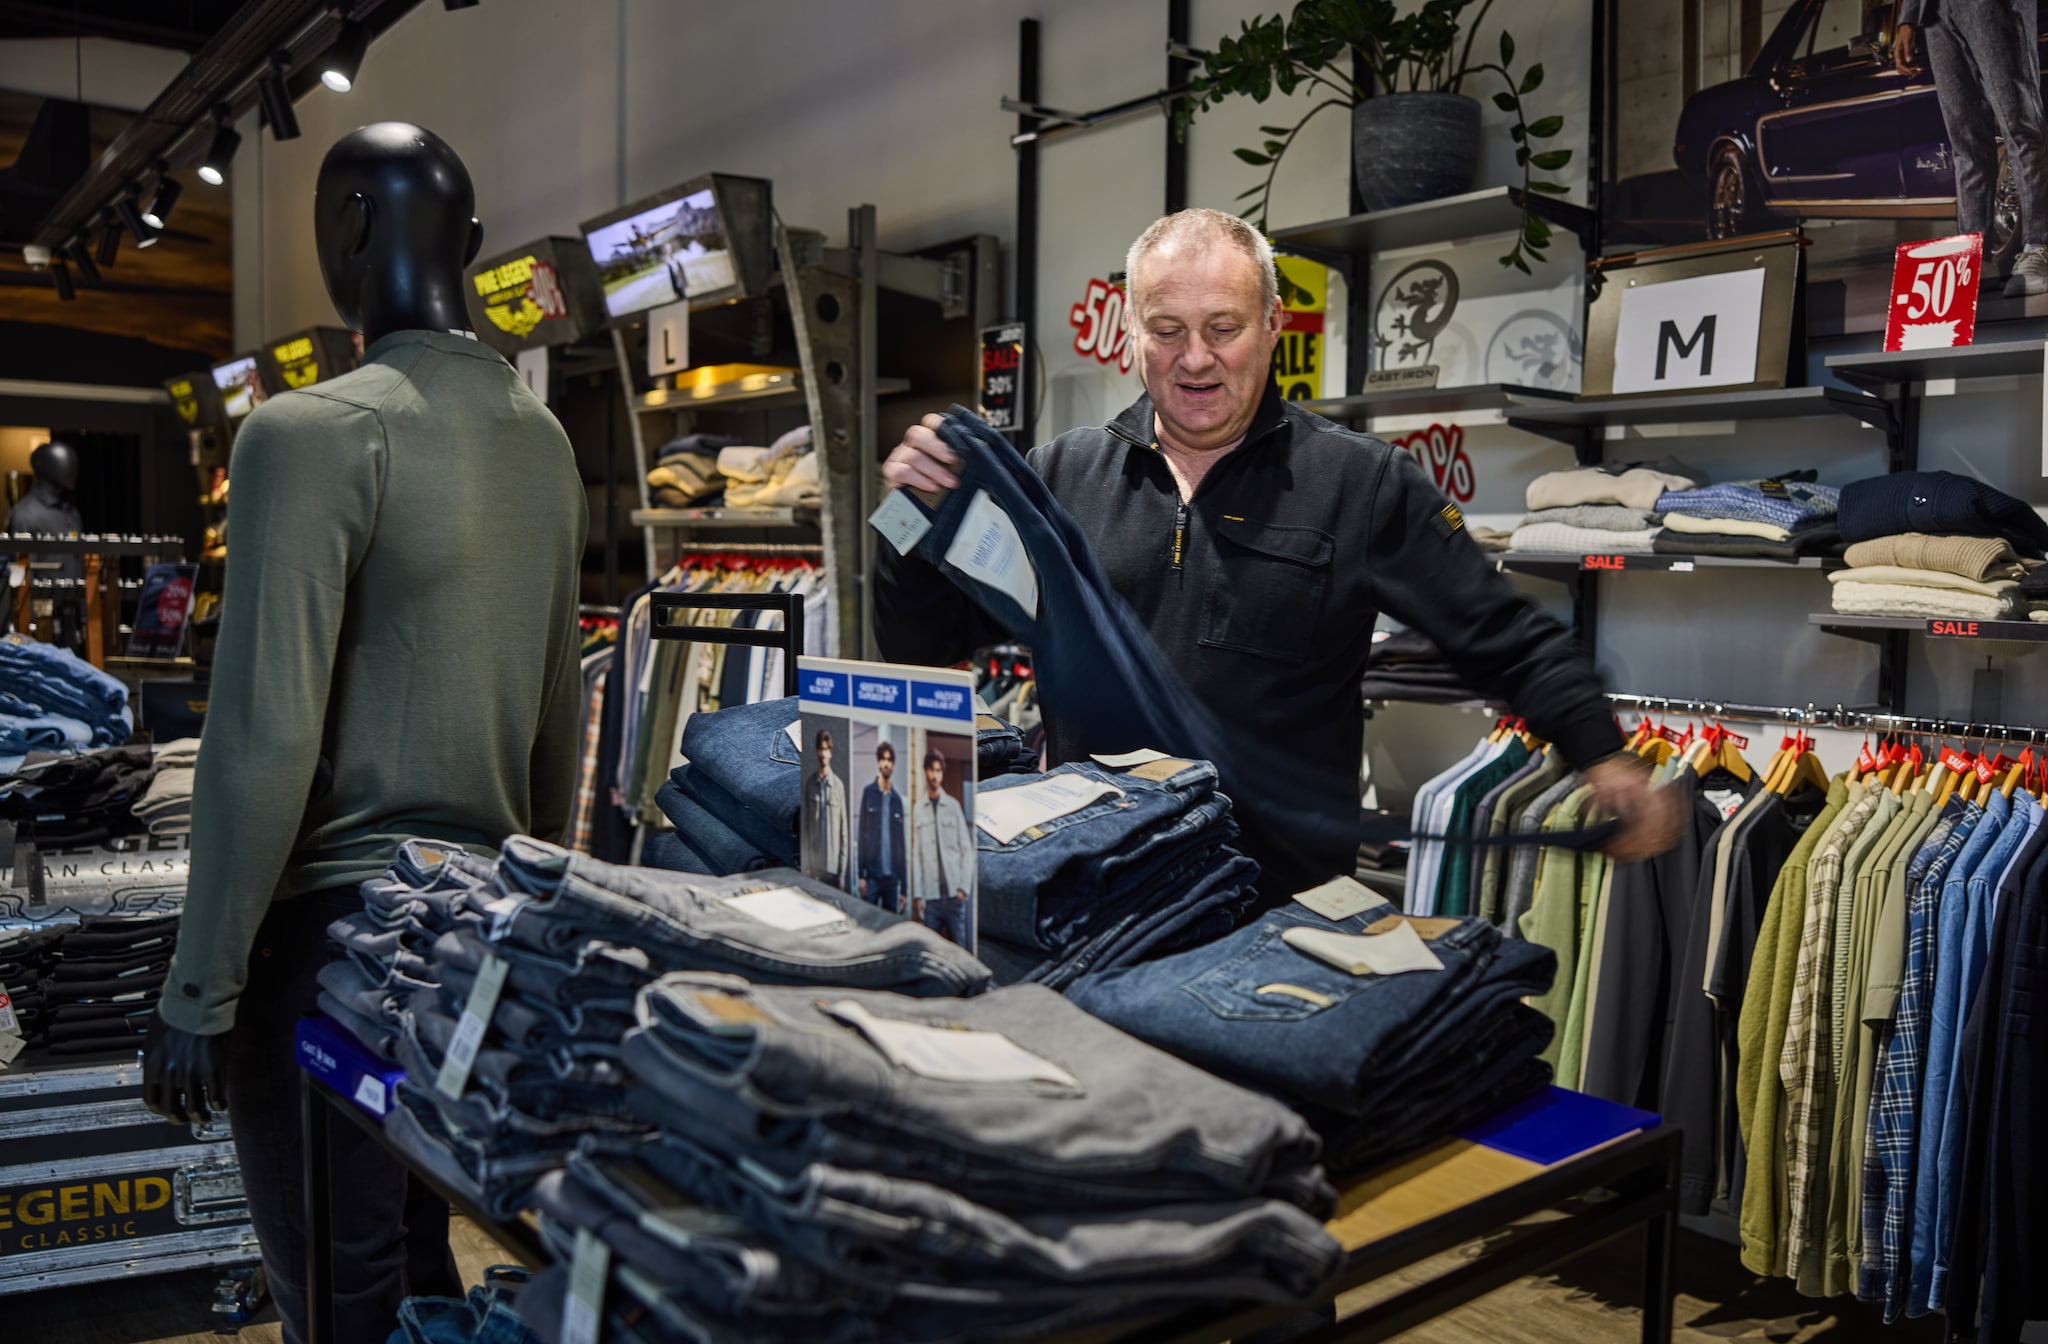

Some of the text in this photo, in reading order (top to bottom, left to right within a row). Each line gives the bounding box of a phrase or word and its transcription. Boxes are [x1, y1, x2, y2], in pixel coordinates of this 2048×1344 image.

[1897, 256, 1970, 320] -50%
[663, 329, 676, 366] L
[983, 346, 1020, 372] SALE
[1272, 333, 1316, 377] ALE
[1654, 314, 1717, 381] M
[1368, 369, 1434, 383] CAST IRON
[1584, 555, 1626, 571] SALE
[1931, 620, 1979, 636] SALE
[1947, 754, 1967, 771] SALE
[21, 1221, 137, 1249] CLASSIC
